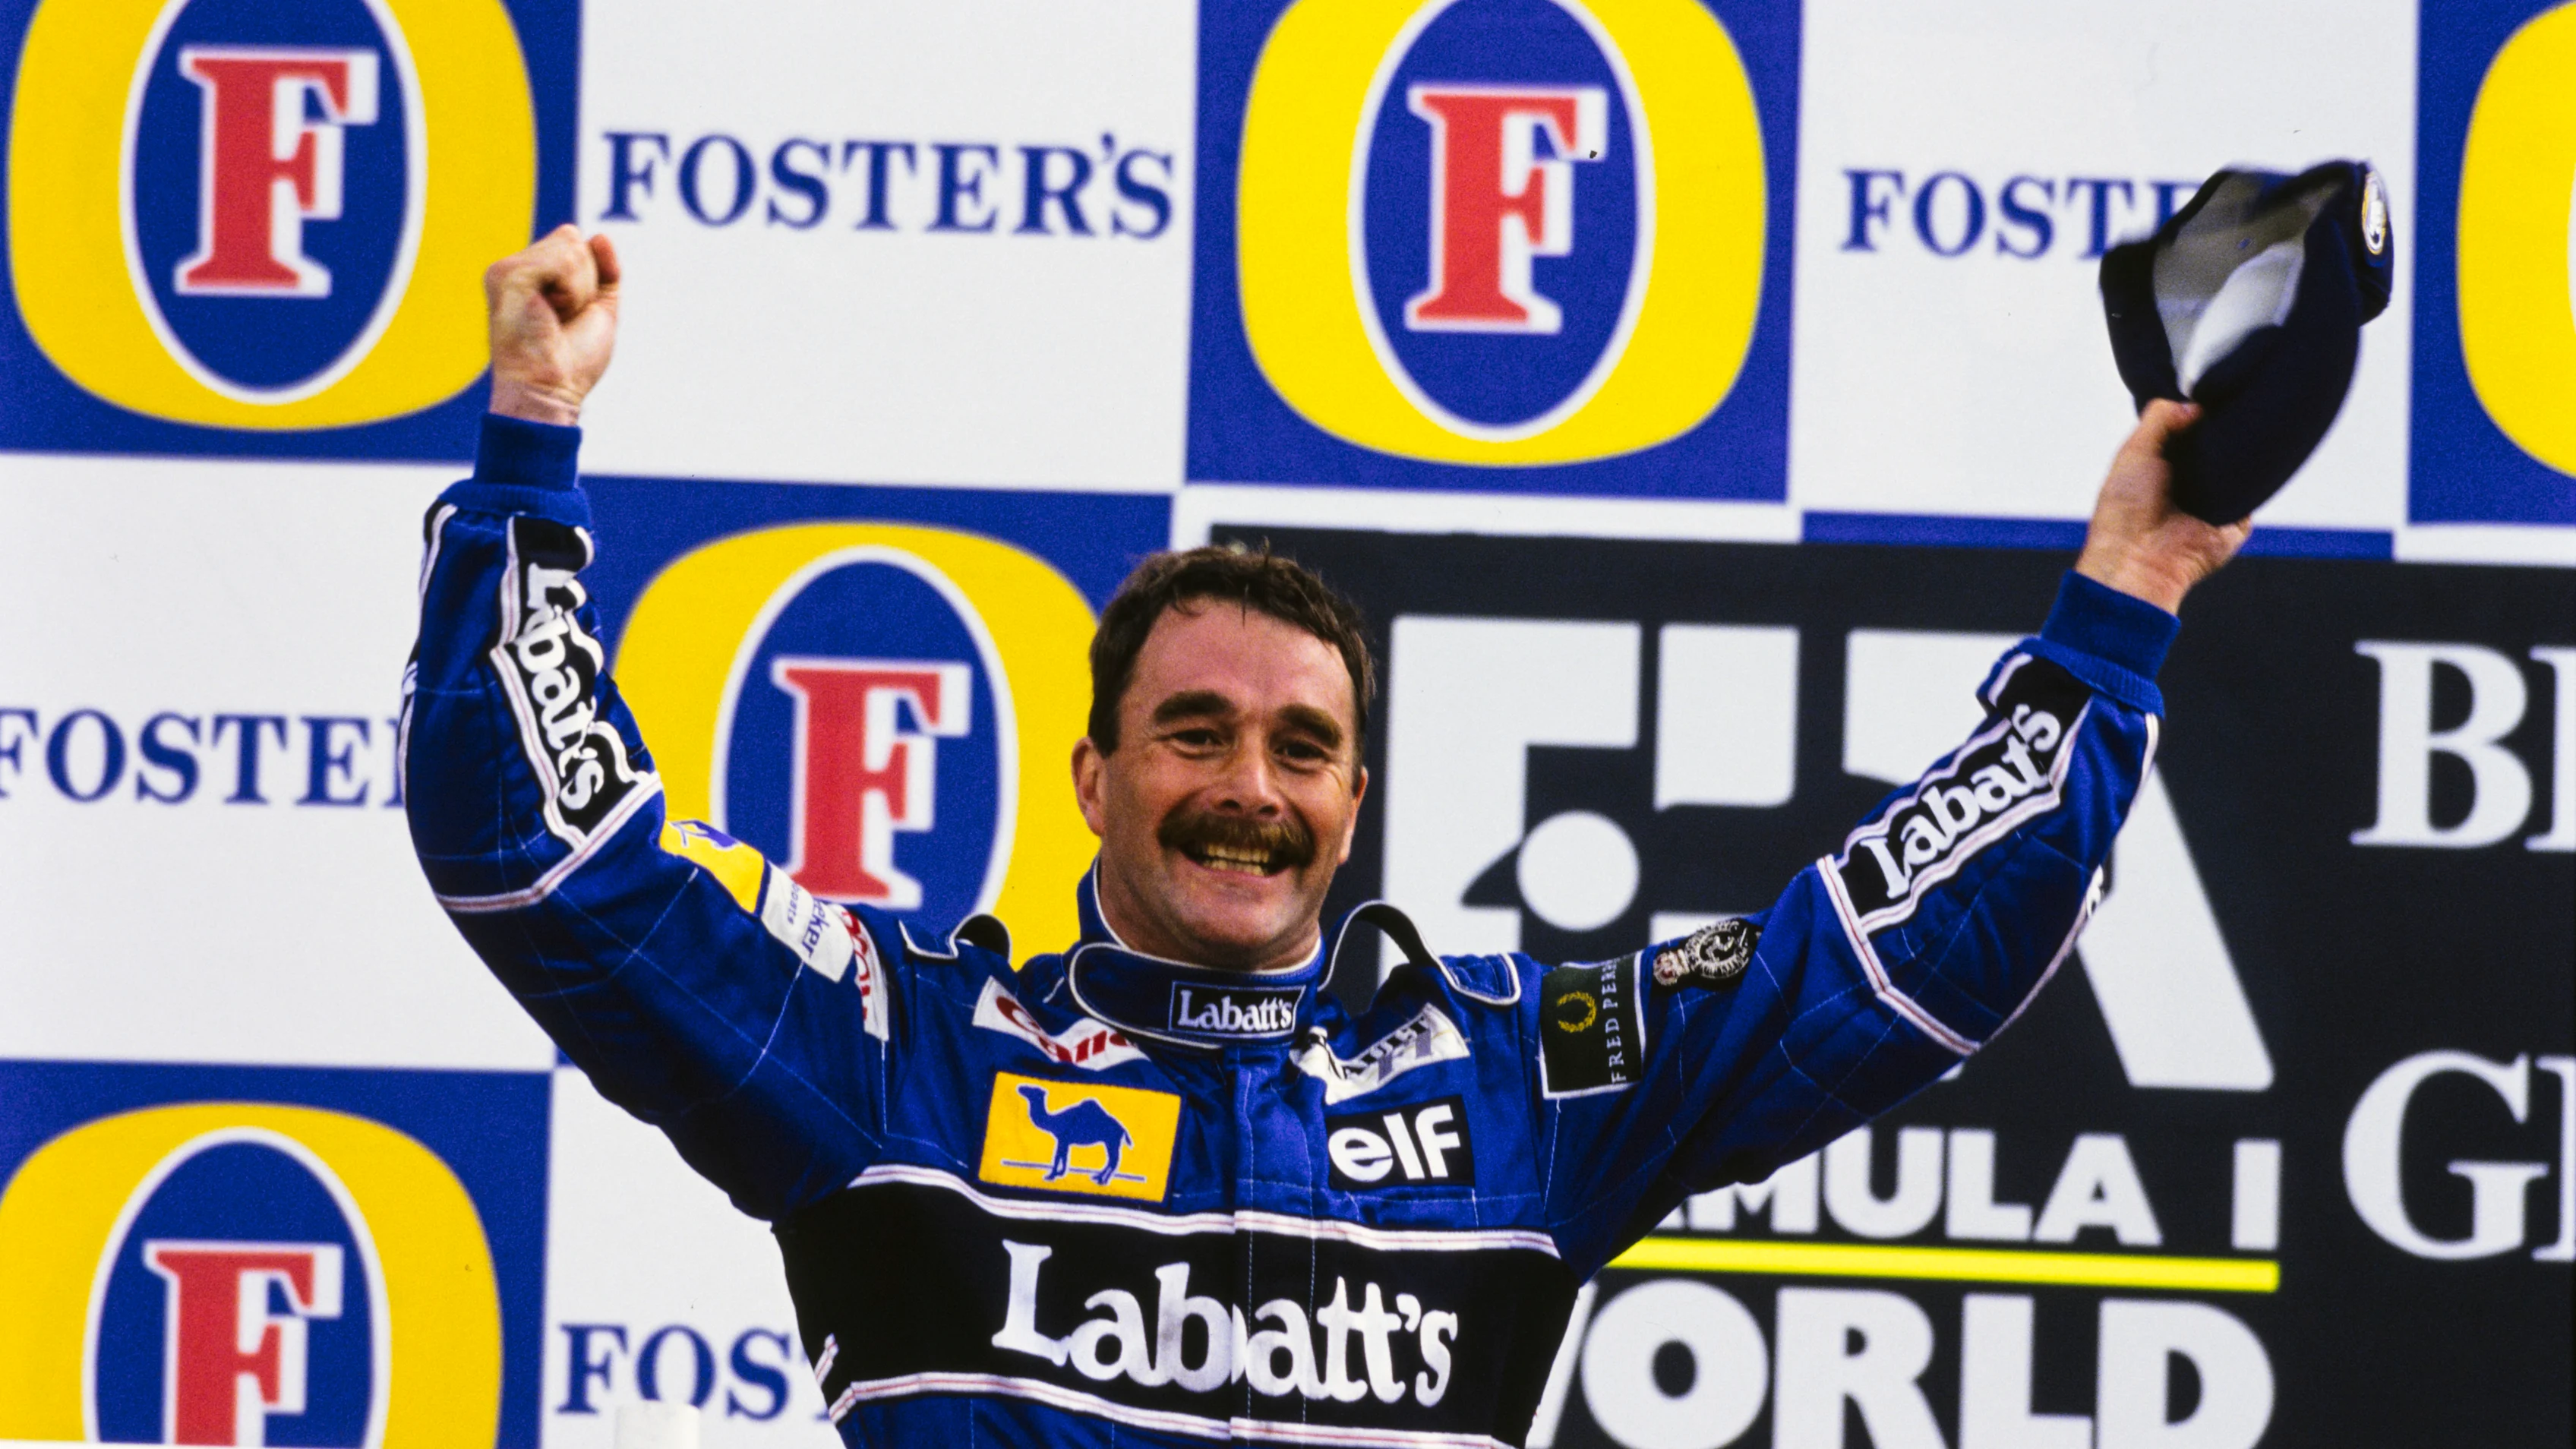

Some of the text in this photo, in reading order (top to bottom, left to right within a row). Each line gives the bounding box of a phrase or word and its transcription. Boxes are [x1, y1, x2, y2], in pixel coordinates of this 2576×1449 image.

[176, 49, 378, 296] F
[598, 131, 1175, 240] FOSTER'S
[1406, 84, 1608, 334] F
[0, 707, 408, 809] FOSTE
[770, 657, 971, 909] F
[801, 897, 831, 959] eker
[1177, 989, 1293, 1032] Labatt's
[1605, 1018, 1627, 1083] FRED
[1327, 1104, 1461, 1182] elf
[1654, 1124, 2163, 1246] MULA
[143, 1239, 343, 1445] F
[556, 1322, 832, 1421] FOS
[991, 1239, 1458, 1406] Labatt's
[1525, 1279, 2275, 1449] ORLD
